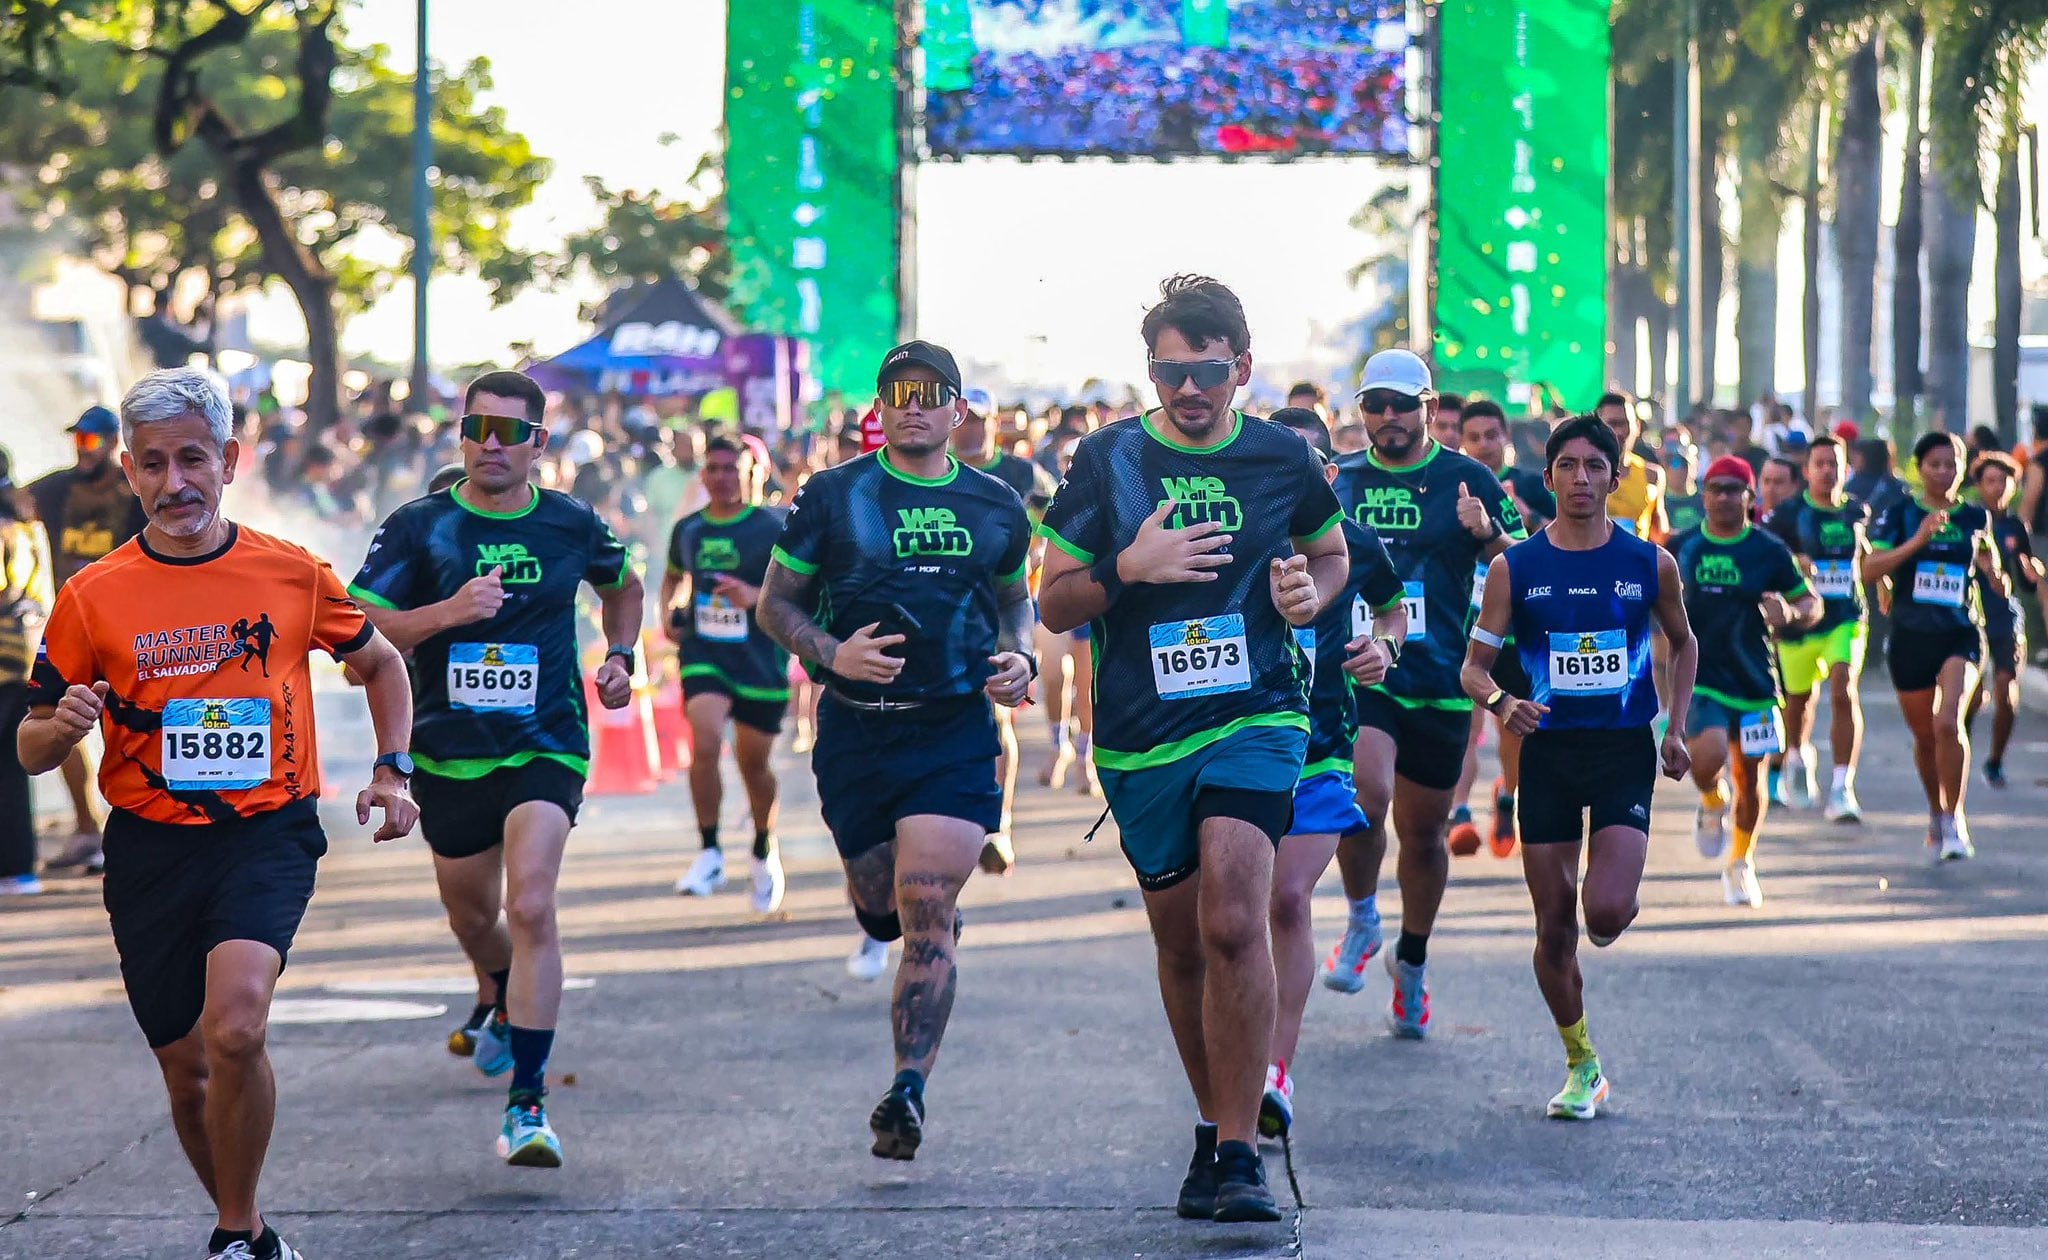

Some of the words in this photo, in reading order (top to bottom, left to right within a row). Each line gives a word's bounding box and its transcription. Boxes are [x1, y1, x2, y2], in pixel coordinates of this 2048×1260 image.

[1160, 476, 1226, 502] we
[1189, 489, 1207, 501] all
[1364, 487, 1412, 506] we
[897, 507, 957, 529] we
[922, 520, 940, 530] all
[1355, 503, 1422, 530] run
[476, 543, 528, 561] we
[894, 527, 974, 557] run
[1568, 587, 1598, 595] MACA
[134, 624, 227, 651] MASTER
[137, 639, 246, 671] RUNNERS
[1158, 642, 1241, 675] 16673
[1556, 653, 1621, 676] 16138
[138, 671, 151, 682] EL
[153, 661, 217, 679] SALVADOR
[453, 667, 532, 690] 15603
[203, 720, 213, 729] 10
[214, 720, 230, 730] km
[204, 710, 228, 722] run
[282, 681, 296, 764] MASTER
[166, 731, 265, 760] 15882
